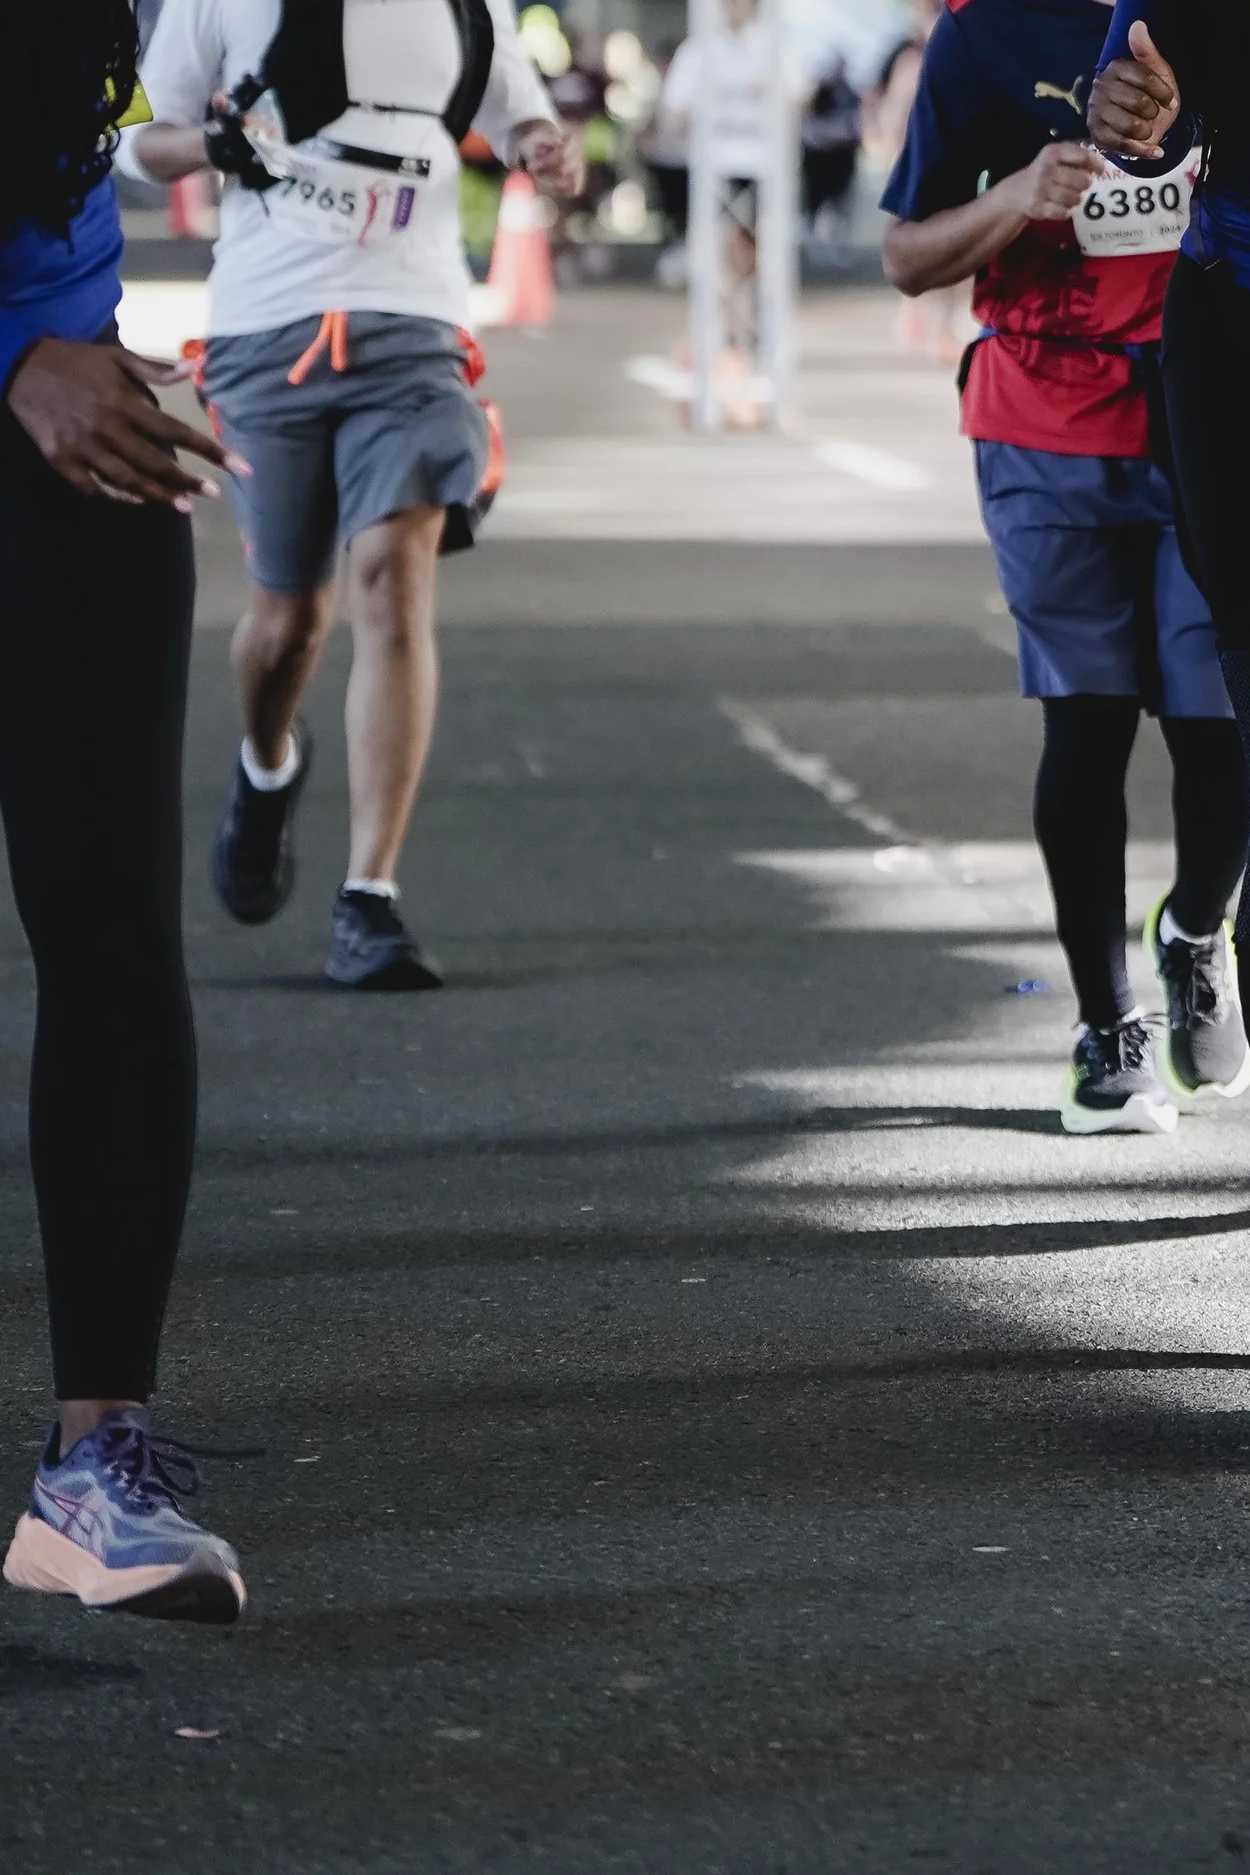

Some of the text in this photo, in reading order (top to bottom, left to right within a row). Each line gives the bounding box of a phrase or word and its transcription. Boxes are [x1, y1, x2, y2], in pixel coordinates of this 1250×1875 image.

[280, 175, 356, 216] 7965
[1083, 183, 1180, 221] 6380
[1160, 224, 1181, 235] 2024
